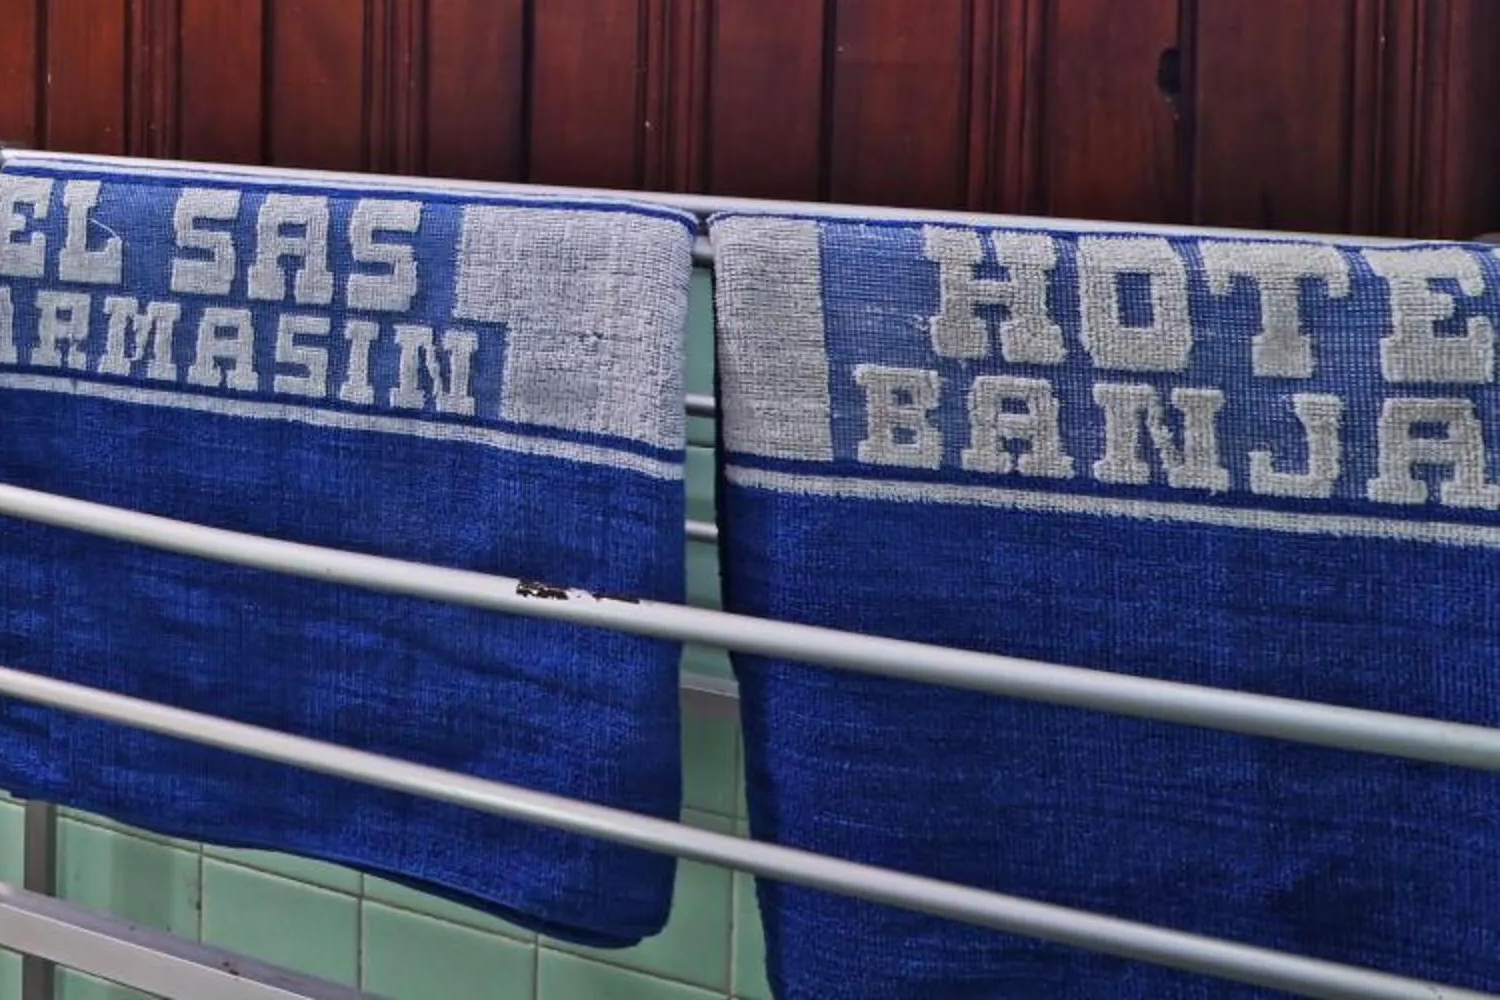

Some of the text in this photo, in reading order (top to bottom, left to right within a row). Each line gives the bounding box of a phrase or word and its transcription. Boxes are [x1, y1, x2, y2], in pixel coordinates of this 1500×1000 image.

[171, 187, 422, 311] SAS
[923, 224, 1500, 384] HOTE
[853, 363, 1500, 510] BANJA
